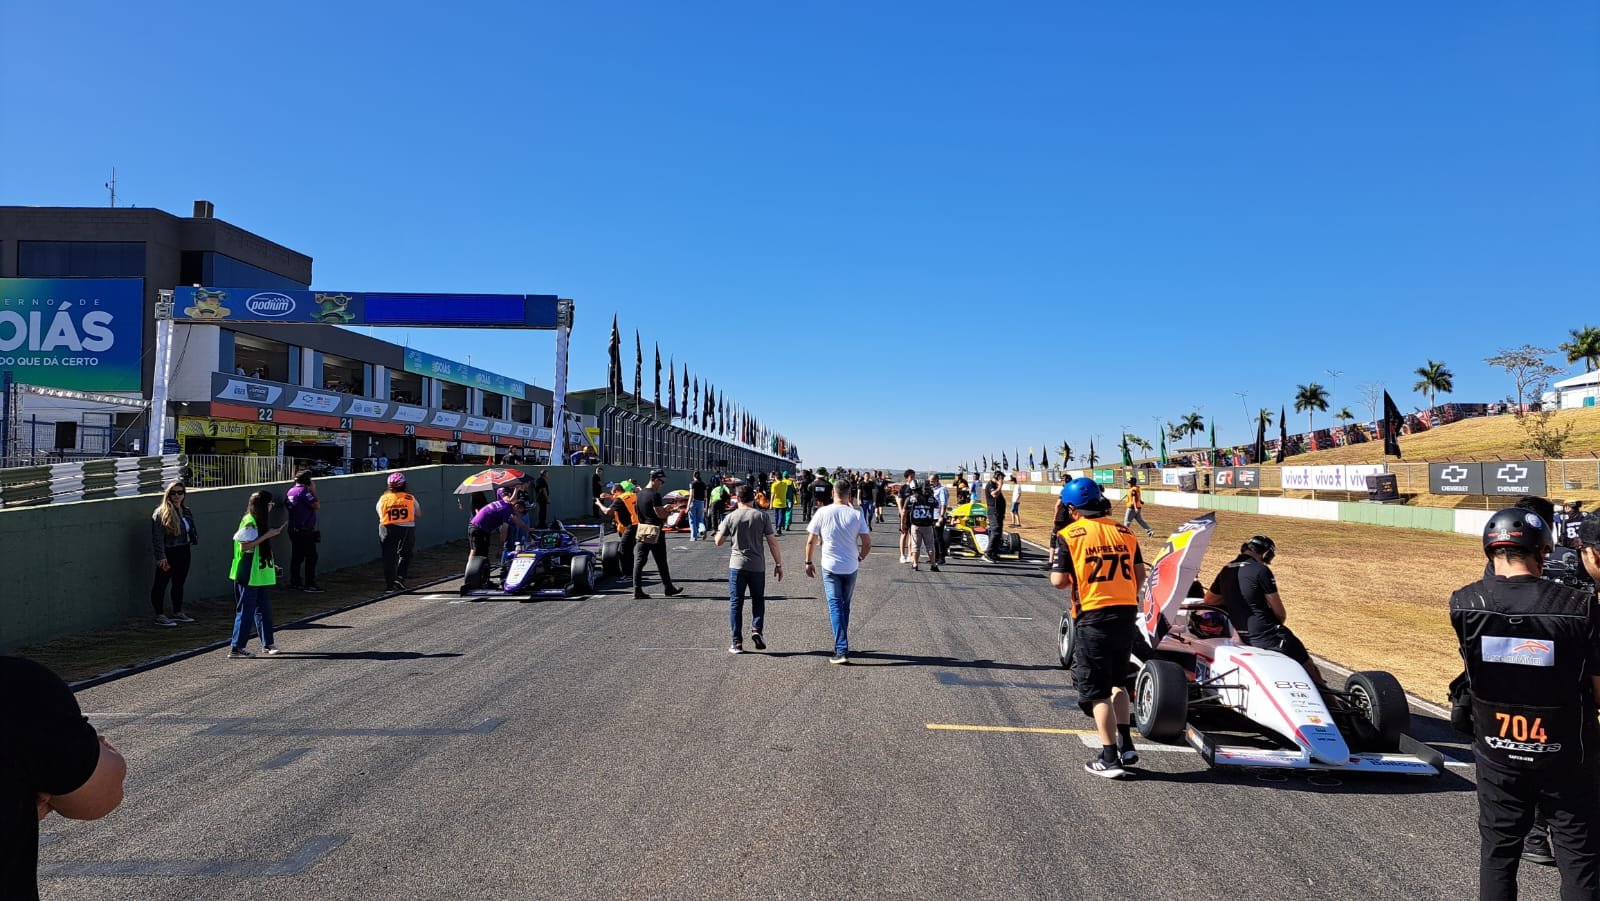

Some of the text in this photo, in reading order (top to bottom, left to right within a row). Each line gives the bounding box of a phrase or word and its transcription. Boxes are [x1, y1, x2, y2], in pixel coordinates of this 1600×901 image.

[251, 299, 289, 311] podium
[0, 300, 115, 352] OIÁS
[17, 357, 41, 366] QUE
[43, 354, 59, 366] DÁ
[61, 357, 99, 366] CERTO
[259, 408, 273, 421] 22
[341, 418, 352, 430] 21
[405, 424, 415, 435] 20
[1216, 470, 1233, 485] GR
[1285, 469, 1302, 486] vivo
[1315, 469, 1333, 486] vivo
[385, 508, 409, 522] 199
[913, 509, 932, 519] 824
[1085, 544, 1129, 555] IMPRENSA
[1085, 553, 1132, 584] 276
[1274, 680, 1311, 690] 88
[1496, 712, 1547, 743] 704
